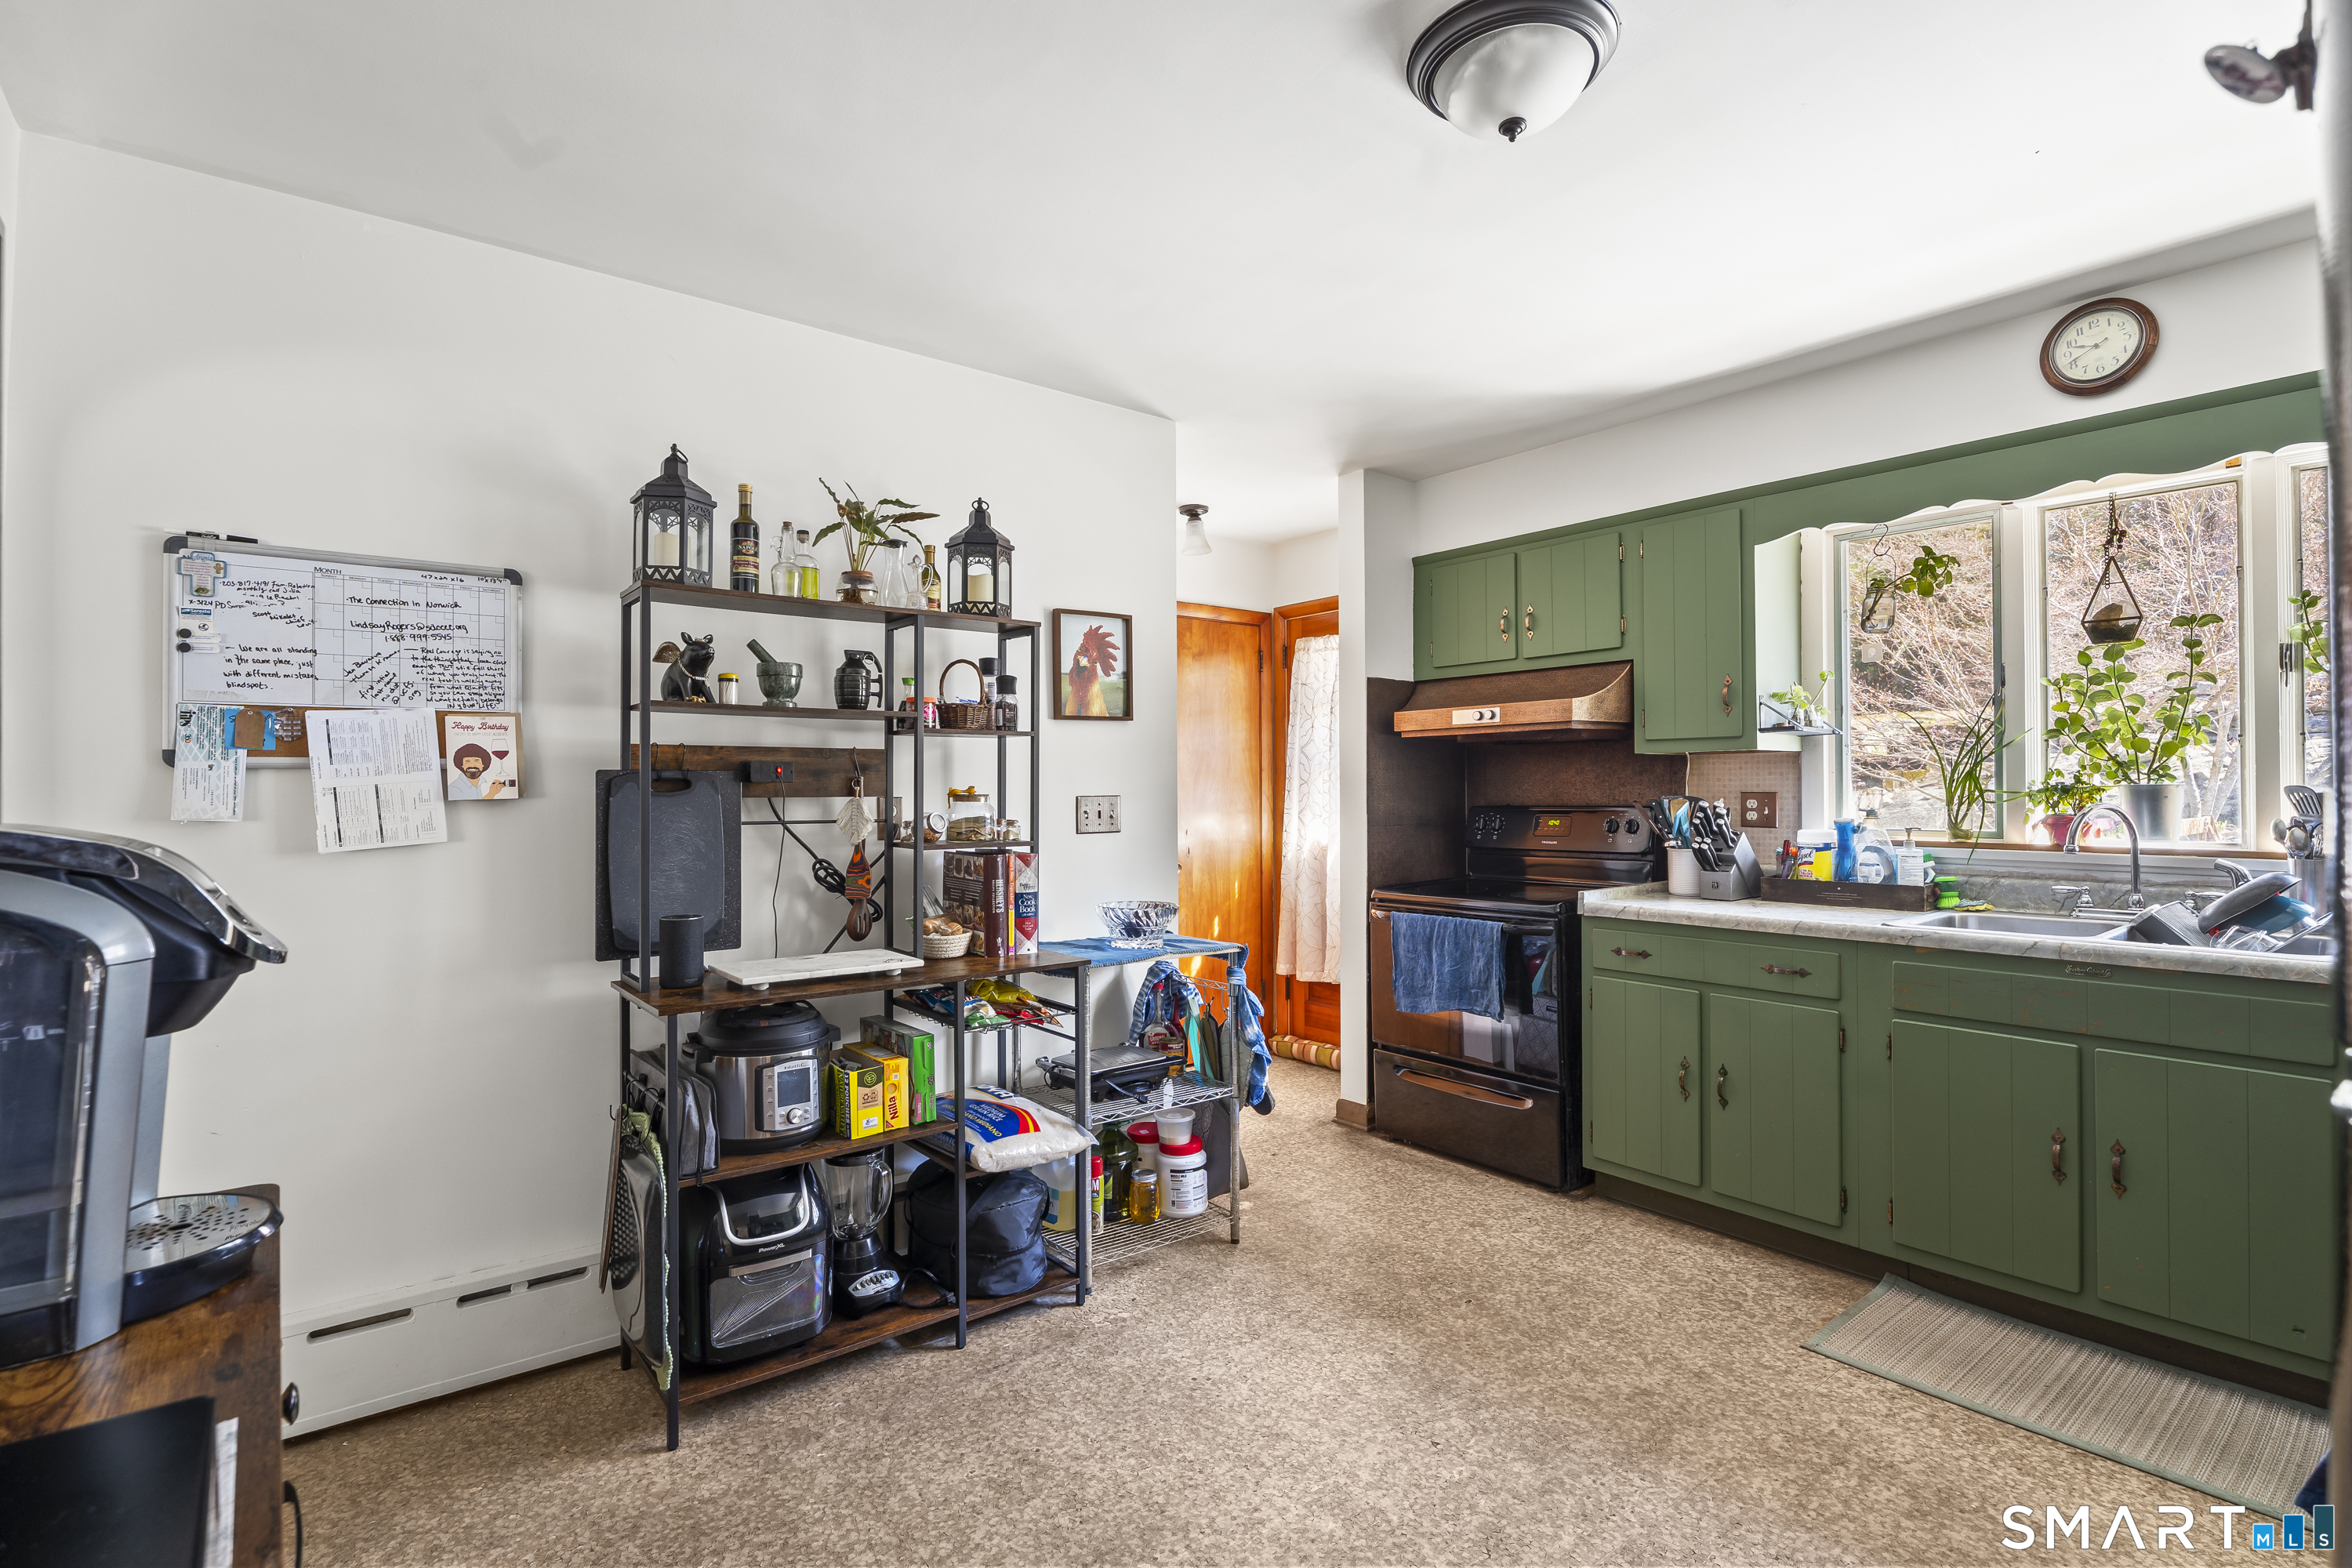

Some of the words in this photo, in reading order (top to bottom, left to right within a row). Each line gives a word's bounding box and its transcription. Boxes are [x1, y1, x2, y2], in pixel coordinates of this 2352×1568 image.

[2089, 318, 2100, 330] 12
[2107, 318, 2111, 327] 1
[2118, 321, 2126, 332] 2
[2076, 327, 2083, 336] 11
[2063, 350, 2072, 360] 9
[2070, 361, 2078, 370] 8
[2111, 356, 2119, 366] 5
[2082, 365, 2089, 374] 7
[2096, 364, 2105, 373] 6
[288, 648, 317, 656] standing
[296, 660, 313, 670] just
[246, 670, 281, 678] different
[451, 721, 475, 731] Happy
[477, 721, 509, 731] Birthday
[996, 879, 1004, 913] HERSHEY'S
[1018, 898, 1036, 906] Cook
[844, 1074, 849, 1083] 12
[887, 1096, 898, 1120] Nilla
[969, 1104, 989, 1115] GRAIN
[987, 1113, 1004, 1122] RICE
[979, 1104, 1007, 1118] MEDIUM
[975, 1117, 1003, 1137] MEDIANO
